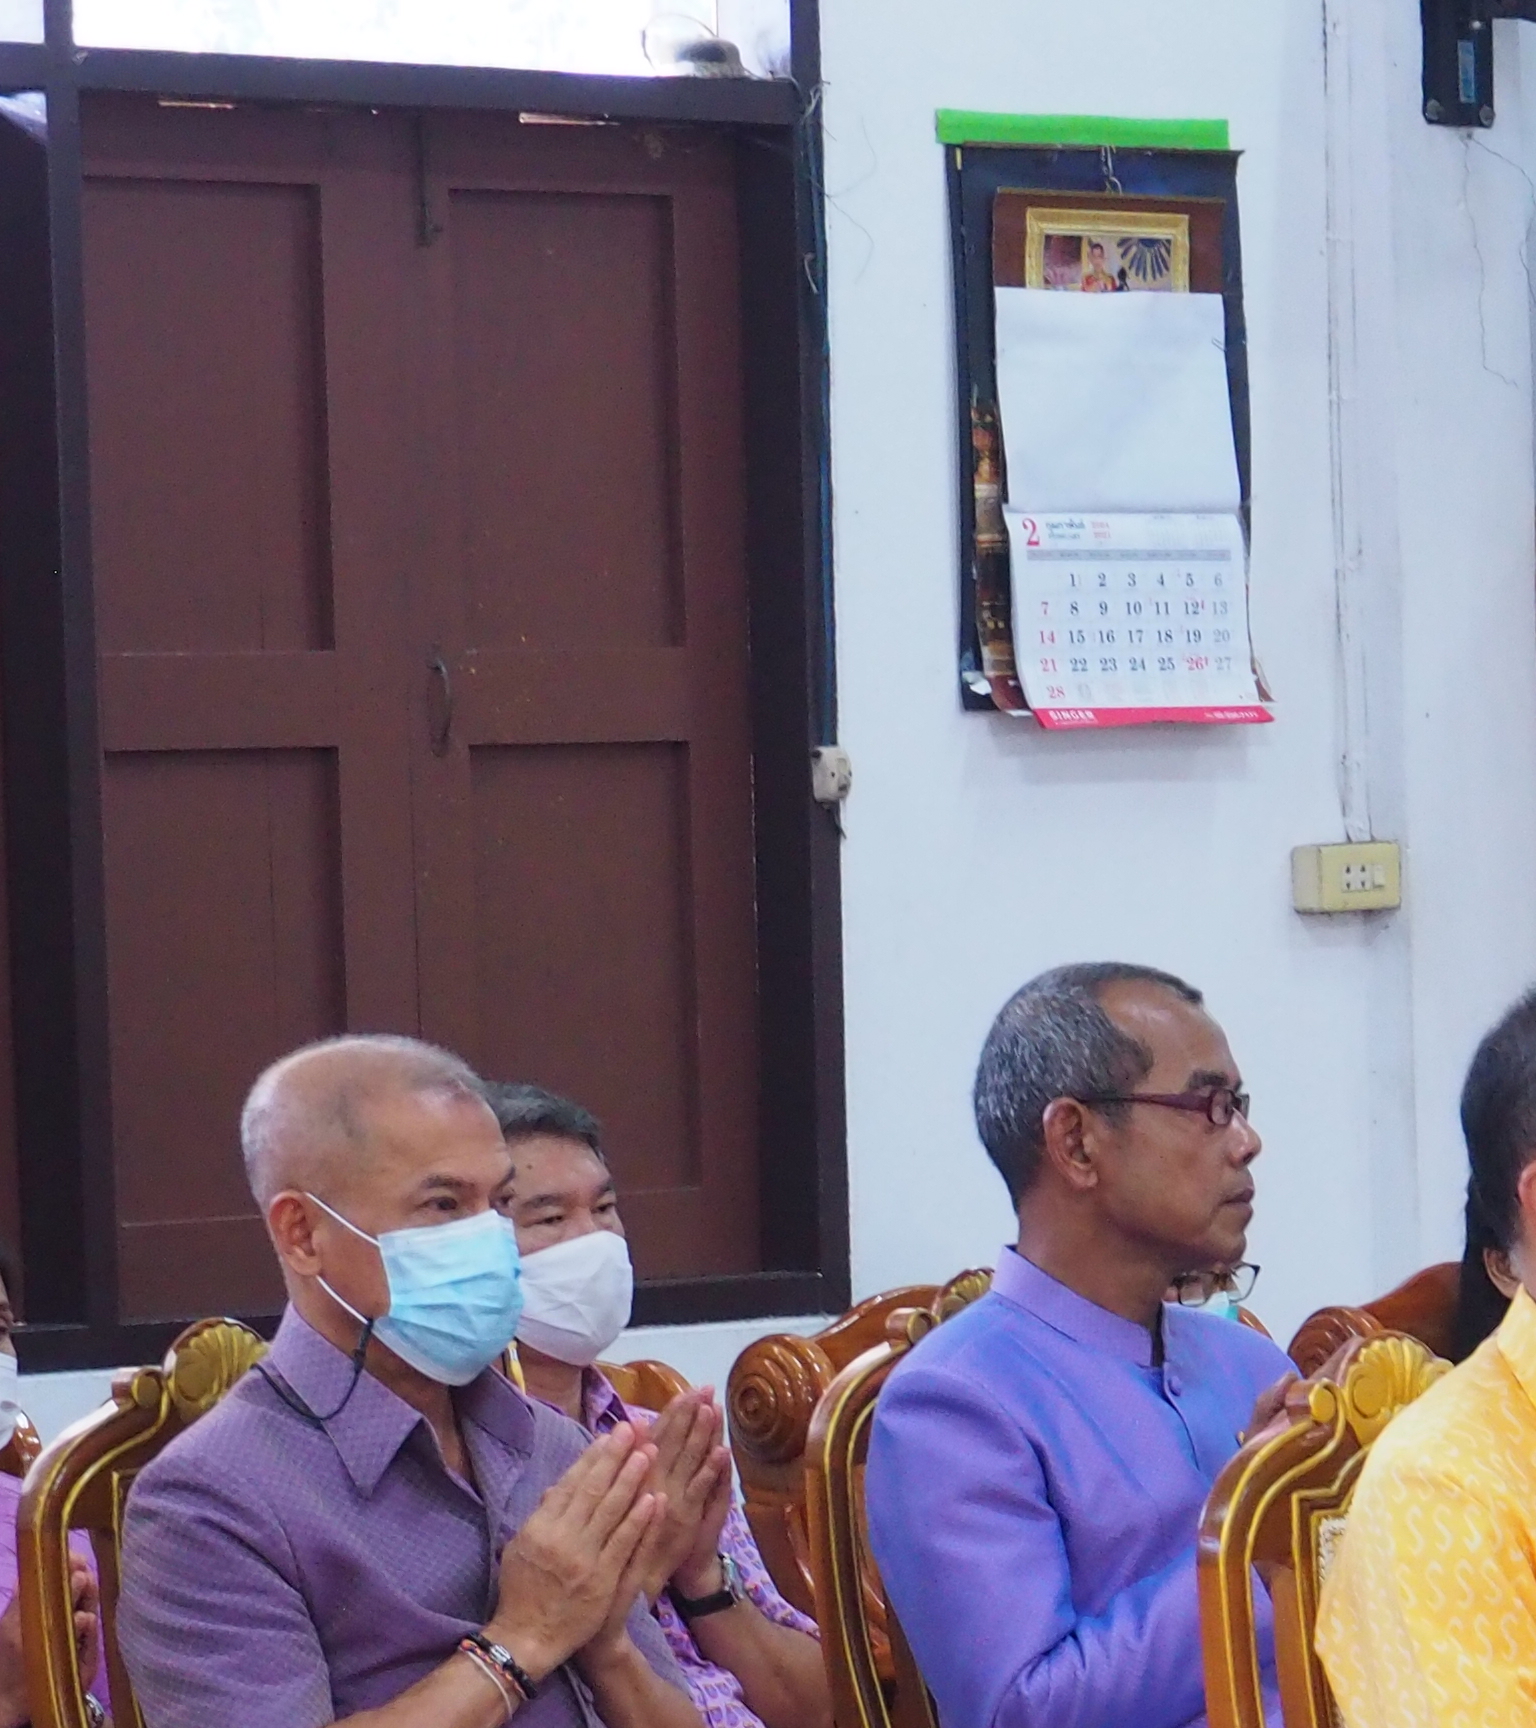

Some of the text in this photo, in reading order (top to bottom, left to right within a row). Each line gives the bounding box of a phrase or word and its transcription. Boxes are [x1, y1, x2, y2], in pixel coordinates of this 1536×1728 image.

[1022, 517, 1041, 547] 2
[1068, 572, 1223, 588] 1 2 3 4 5 6
[1041, 600, 1049, 615] 7
[1070, 601, 1079, 615] 8
[1098, 601, 1108, 616] 9
[1125, 601, 1143, 616] 10
[1154, 601, 1170, 616] 11
[1184, 601, 1200, 616] 12
[1039, 630, 1055, 644] 14
[1068, 629, 1086, 644] 15
[1098, 629, 1116, 644] 16
[1127, 628, 1144, 644] 17
[1157, 629, 1173, 643] 18
[1186, 629, 1202, 644] 19
[1039, 658, 1057, 672] 21
[1069, 657, 1089, 673] 22
[1099, 657, 1118, 672] 23
[1128, 657, 1146, 672] 24
[1157, 656, 1176, 672] 25
[1186, 656, 1204, 671] 26
